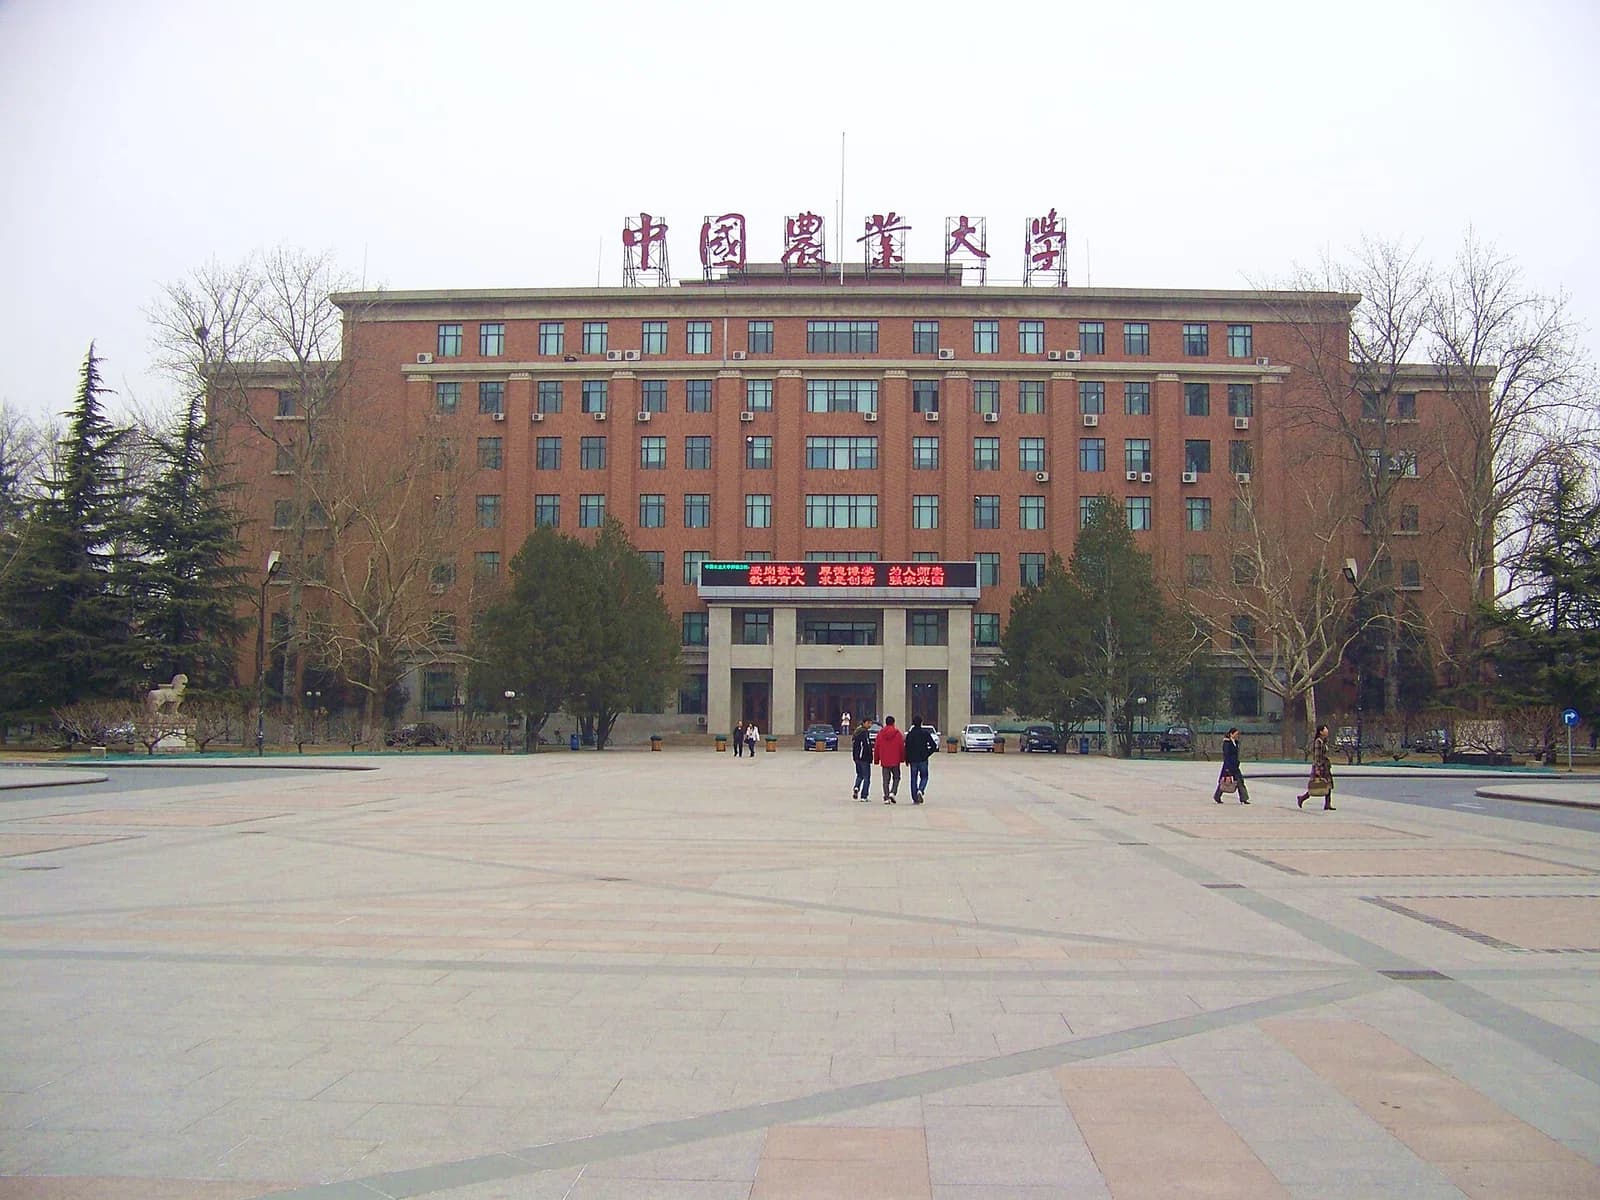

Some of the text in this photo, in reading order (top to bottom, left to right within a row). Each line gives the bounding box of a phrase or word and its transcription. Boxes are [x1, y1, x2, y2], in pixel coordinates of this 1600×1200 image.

[749, 566, 805, 576] 爱岗敬业
[818, 566, 875, 576] 厚德博学
[888, 566, 945, 577] 为人师表
[749, 575, 806, 586] 教书育人
[818, 575, 876, 586] 求是创新
